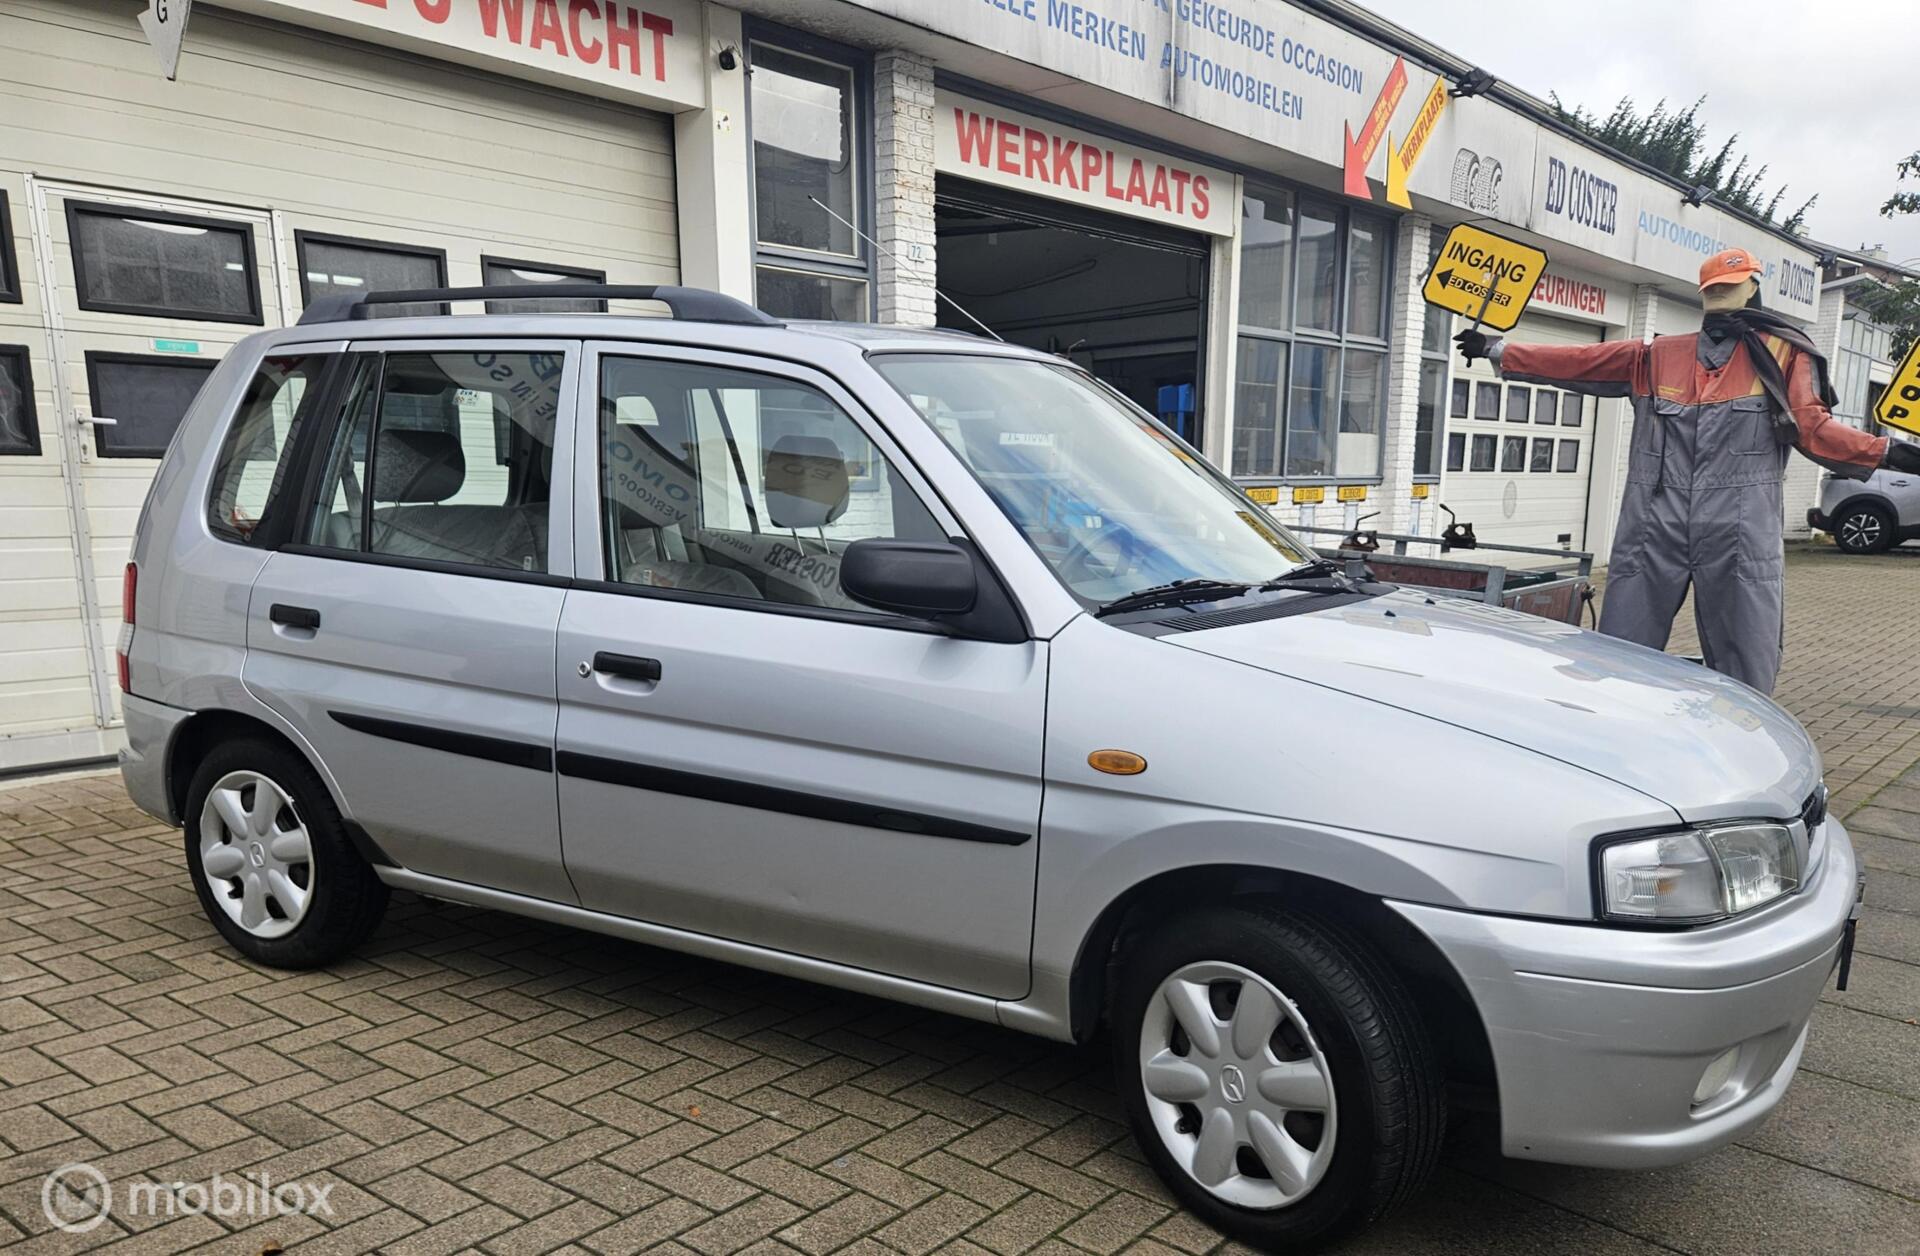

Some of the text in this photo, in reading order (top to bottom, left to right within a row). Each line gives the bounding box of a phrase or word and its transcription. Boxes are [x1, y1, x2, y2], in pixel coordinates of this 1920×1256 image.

[477, 0, 674, 83] WACHT
[1048, 0, 1146, 61] MERKEN
[1160, 42, 1303, 120] AUTOMOBIELEN
[1176, 0, 1363, 95] GEKEURDE OCCASION
[954, 107, 1210, 220] WERKPLAATS
[1400, 87, 1445, 172] WERKPLAATS
[1545, 156, 1618, 236] ED COSTER
[1447, 240, 1527, 283] INGANG
[1448, 275, 1510, 306] ED COSER
[1530, 272, 1607, 316] EURINGEN
